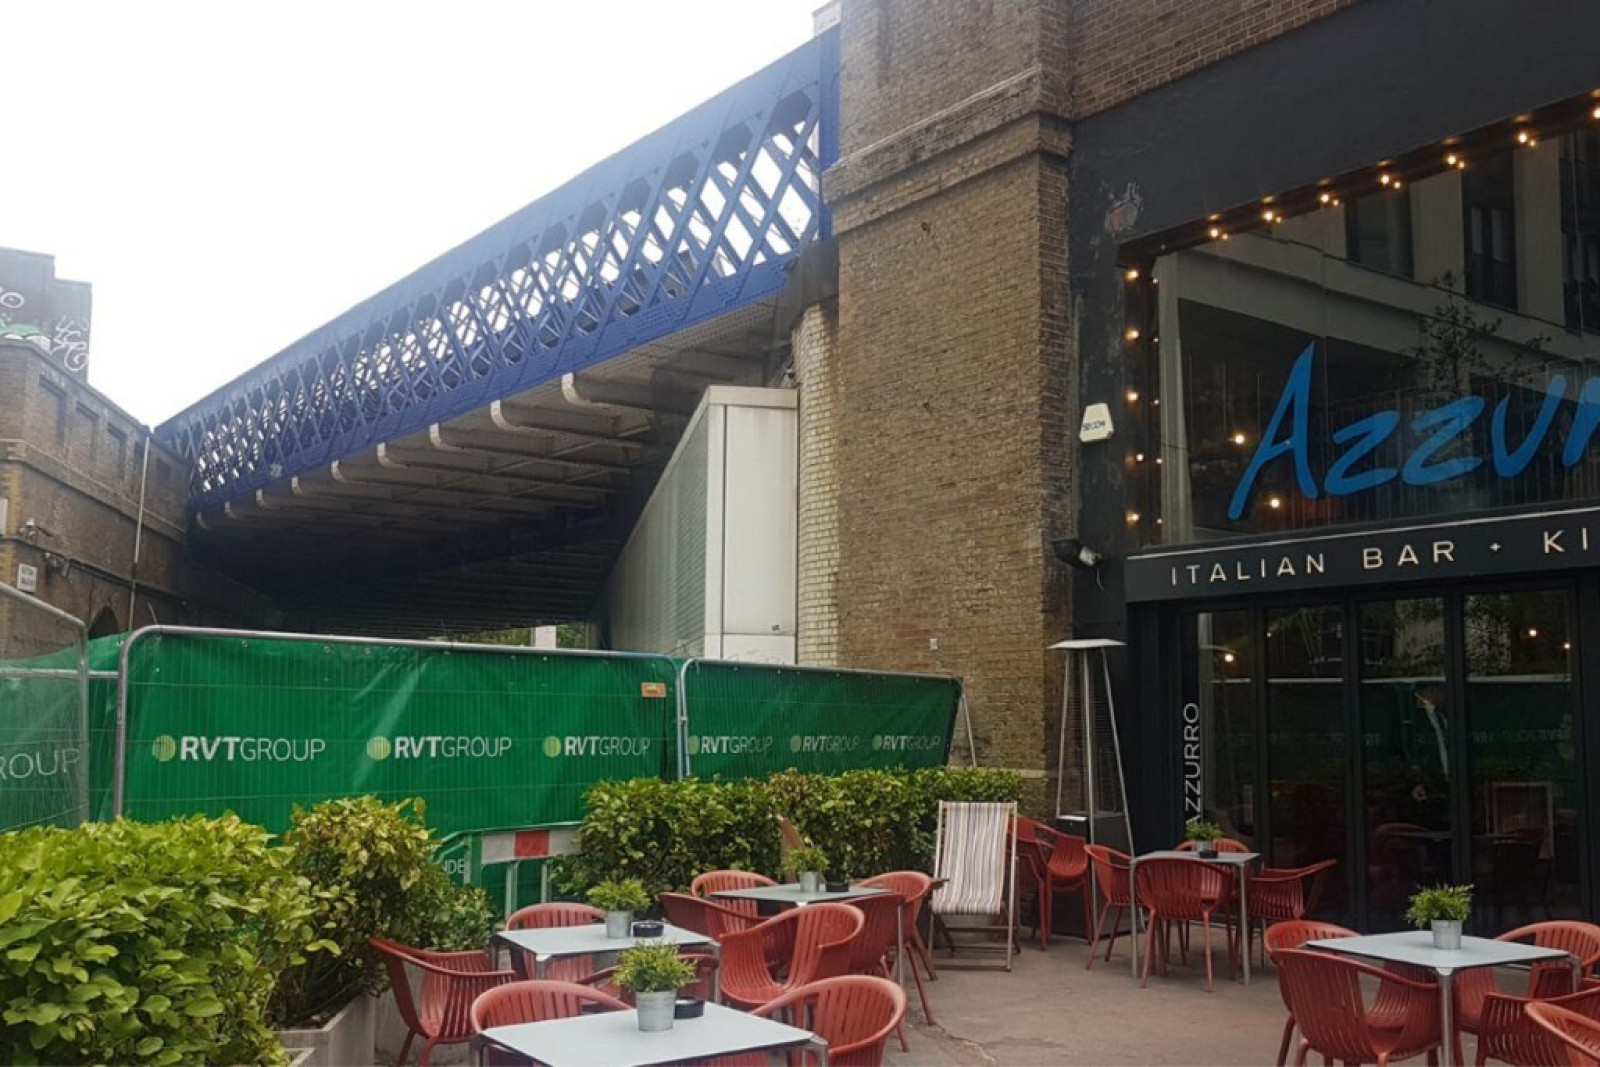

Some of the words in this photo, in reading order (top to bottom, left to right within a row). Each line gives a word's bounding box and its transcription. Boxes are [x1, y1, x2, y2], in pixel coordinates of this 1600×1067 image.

[1171, 552, 1325, 586] ITALIAN
[1363, 540, 1455, 570] BAR
[1543, 526, 1589, 554] KI
[180, 736, 326, 762] RVTGROUP
[394, 736, 512, 759] RVTGROUP
[564, 735, 651, 758] RVTGROUP
[701, 735, 773, 754] RVTGROUP
